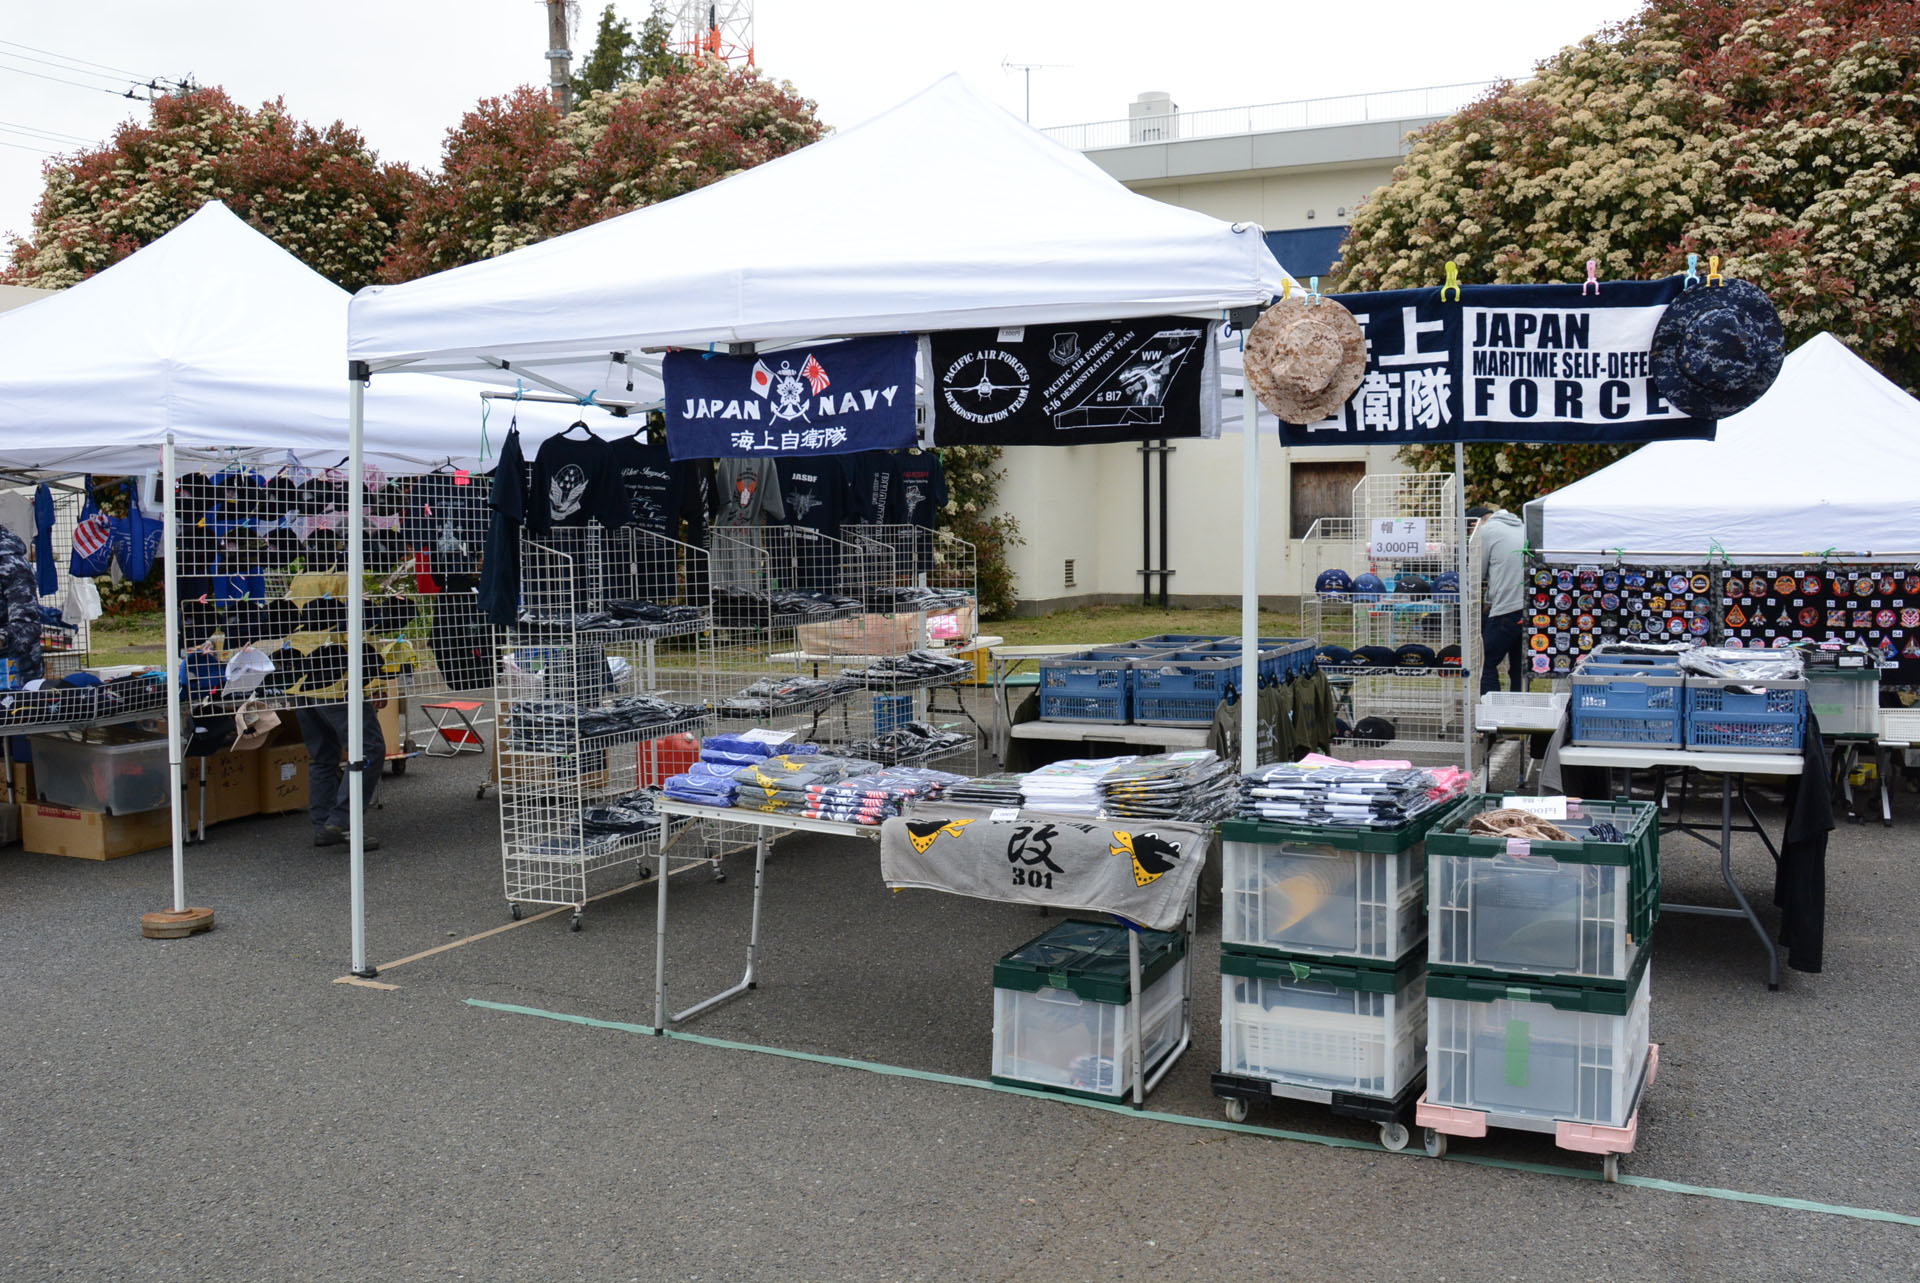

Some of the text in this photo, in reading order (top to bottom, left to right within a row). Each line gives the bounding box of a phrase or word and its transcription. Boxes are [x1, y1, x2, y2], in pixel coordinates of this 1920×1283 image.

[1473, 312, 1590, 349] JAPAN
[943, 352, 974, 384] PACIFIC
[976, 350, 996, 360] AIR
[998, 350, 1030, 382] FORCES
[1043, 369, 1073, 398] PACIFIC
[1071, 357, 1086, 373] AIR
[1084, 330, 1115, 360] FORCES
[1142, 350, 1162, 361] WW
[1473, 350, 1650, 379] MARITIME SELF-DEFE
[1042, 397, 1061, 416] F-16
[1060, 348, 1115, 400] DEMONSTRATION
[1113, 330, 1135, 350] TEAM
[682, 385, 899, 420] JAPAN NAVY
[944, 388, 1029, 423] DEMONSTRATION TEAM
[1105, 391, 1122, 401] 817
[731, 425, 848, 451] 海上自衛隊
[791, 472, 818, 483] JASDF
[1380, 521, 1416, 534] 帽子
[1376, 542, 1419, 553] 3,000円
[1008, 824, 1064, 873] 改
[1012, 867, 1053, 889] 301
